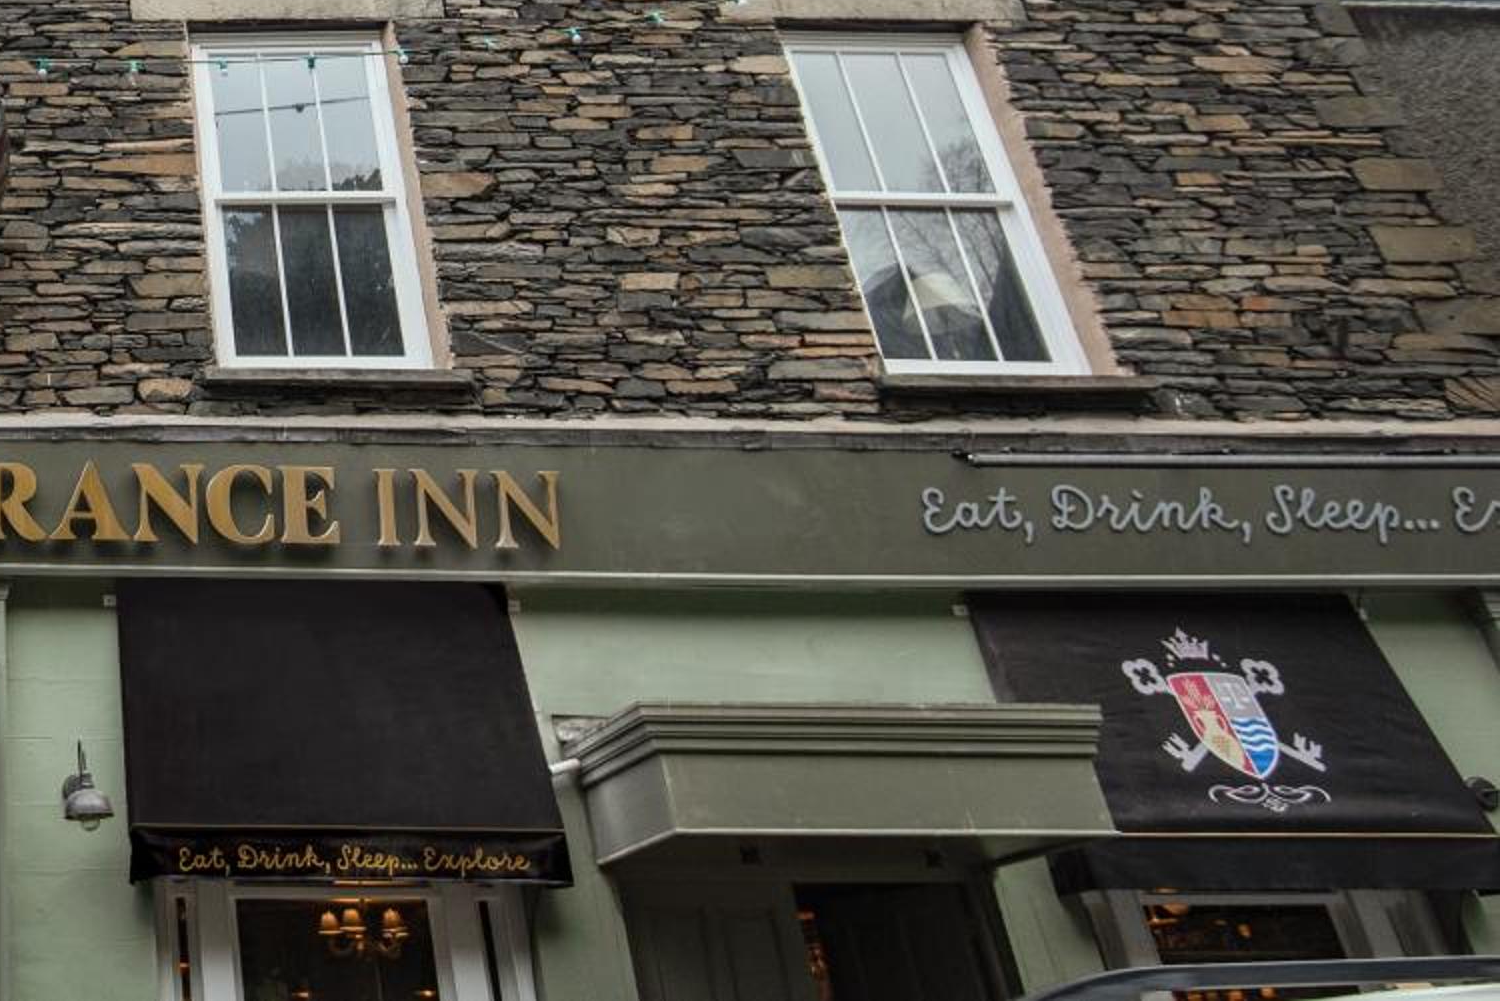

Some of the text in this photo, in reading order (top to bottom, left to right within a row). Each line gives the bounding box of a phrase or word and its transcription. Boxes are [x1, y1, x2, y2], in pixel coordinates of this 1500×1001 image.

[372, 467, 561, 550] INN
[921, 486, 1036, 543] Eat,
[1051, 484, 1251, 543] Drink,
[1265, 484, 1442, 544] Sleep...
[179, 844, 532, 877] Eat, Drink, Sleep... Explore
